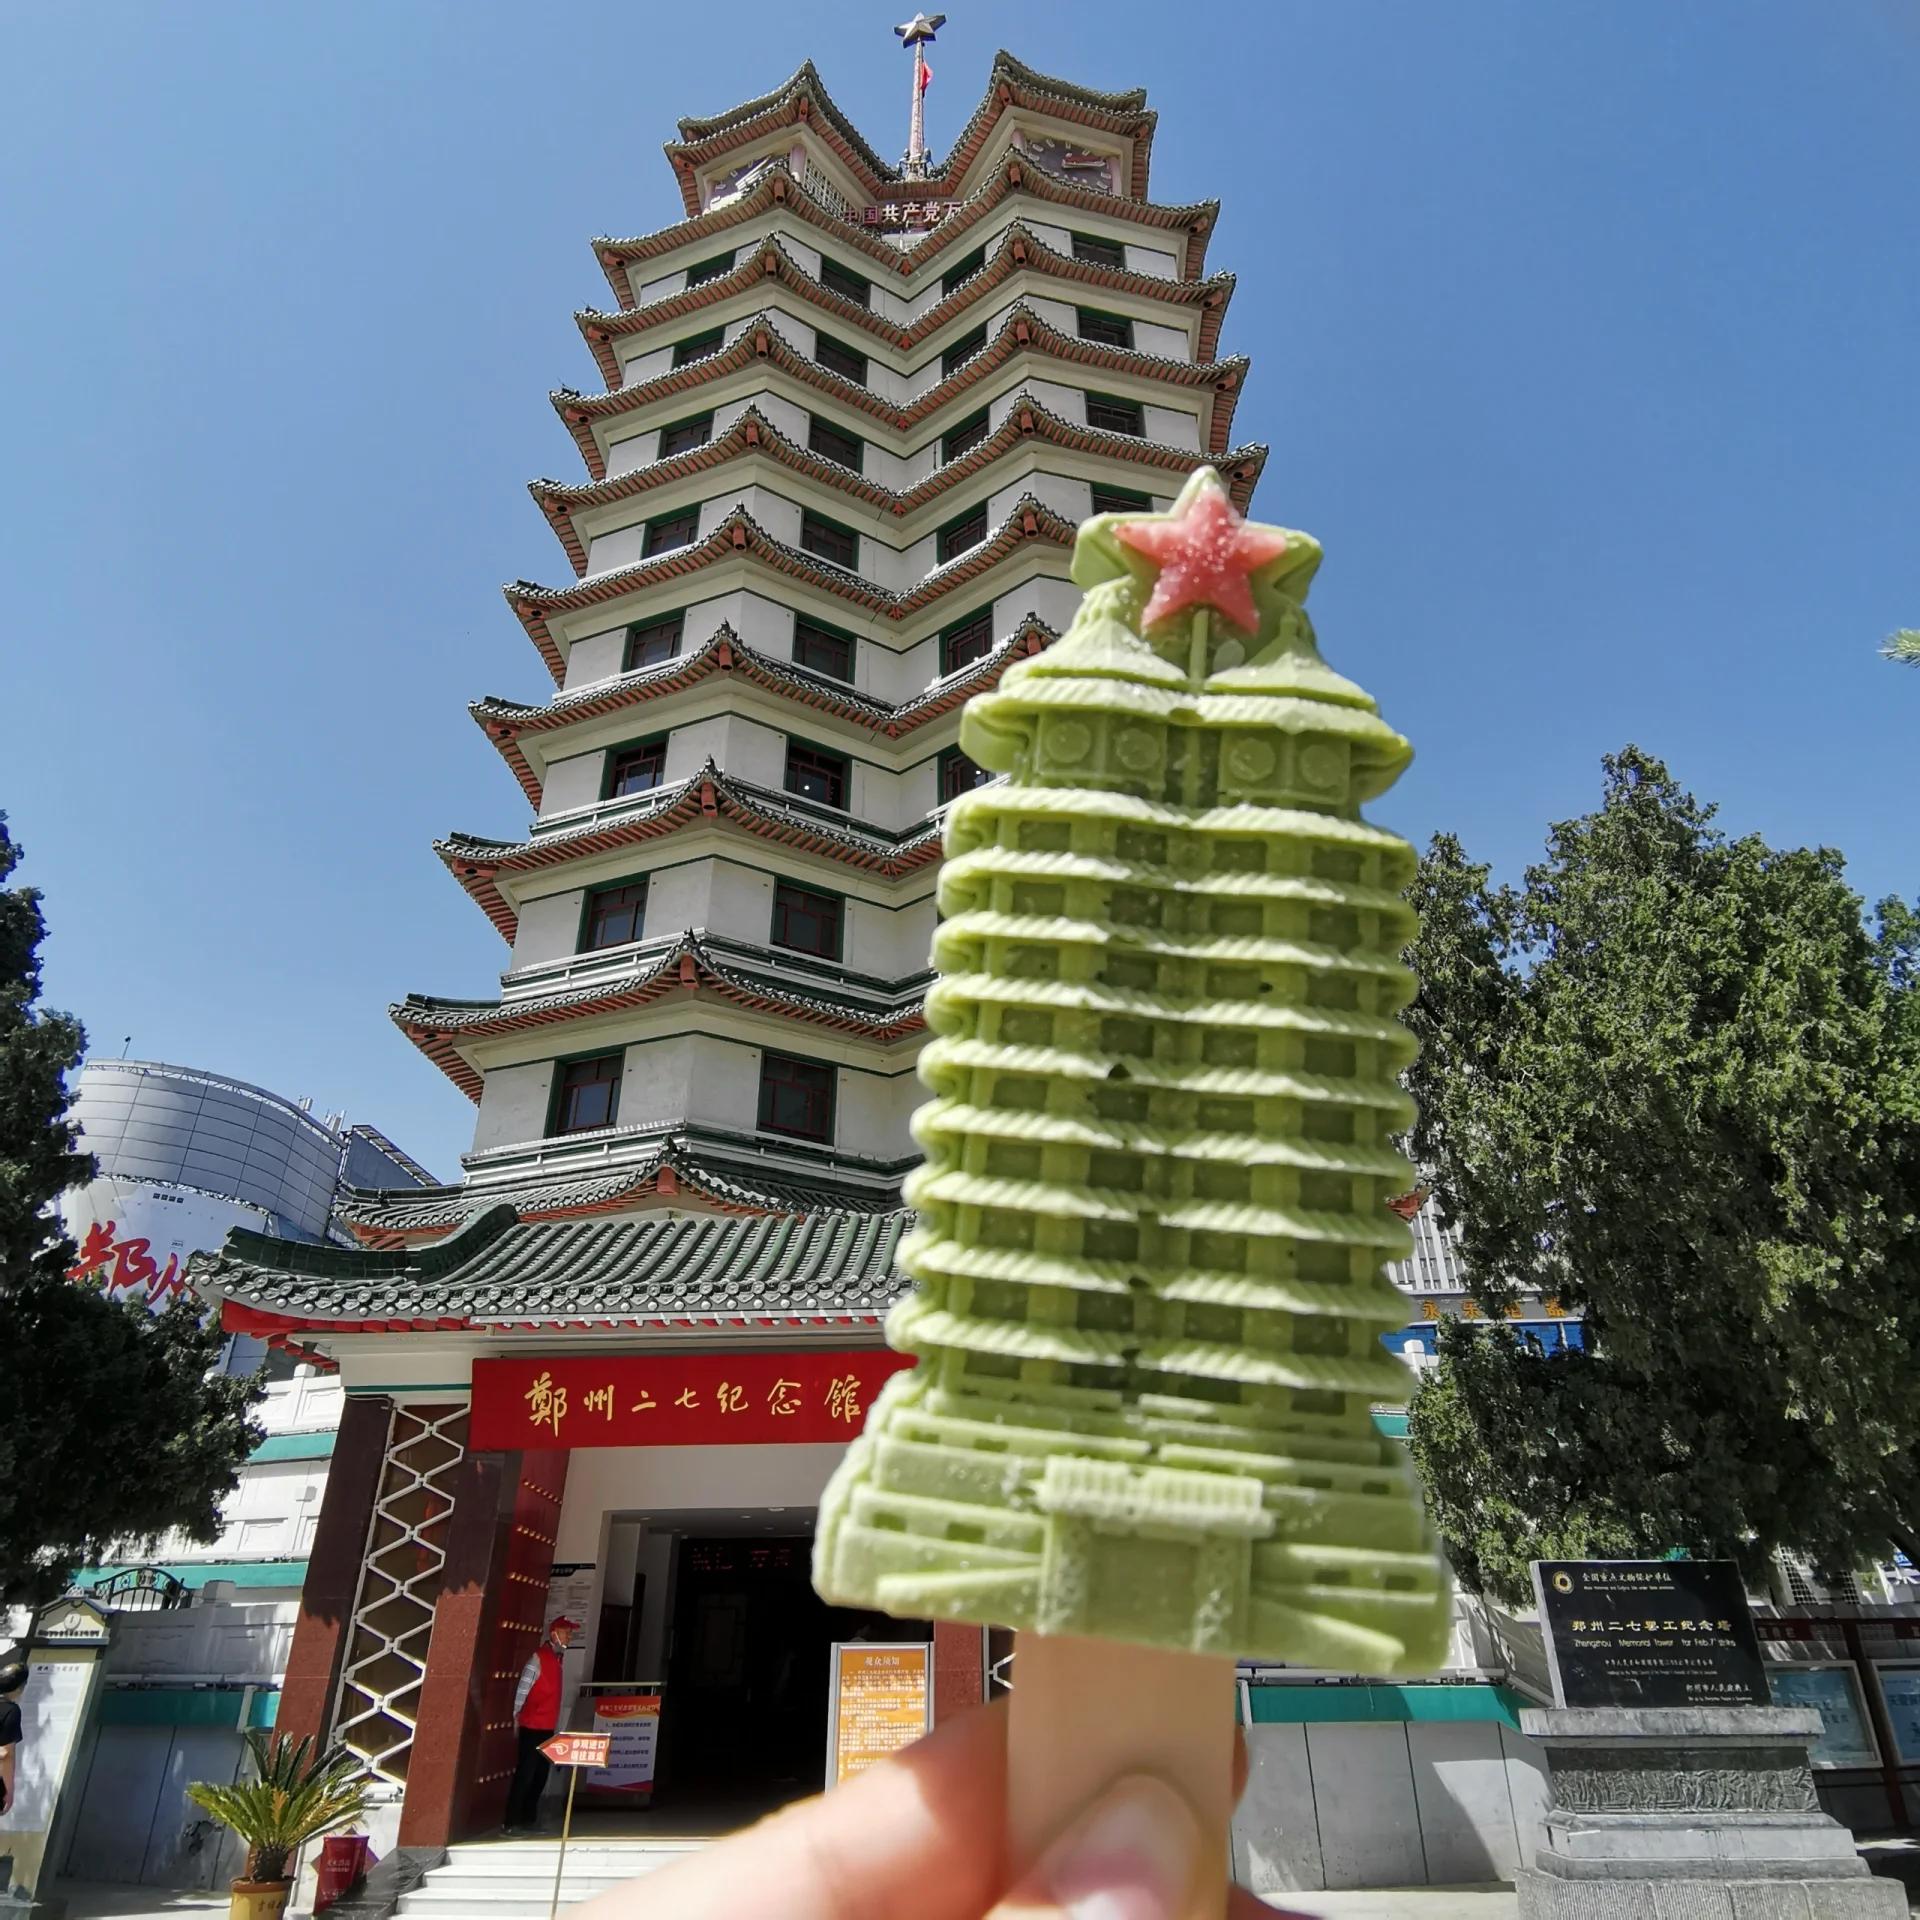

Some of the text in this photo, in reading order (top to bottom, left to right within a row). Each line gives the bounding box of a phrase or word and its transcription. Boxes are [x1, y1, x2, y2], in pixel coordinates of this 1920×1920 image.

[1571, 1619, 1732, 1632] 郑州二七罢工纪念塔
